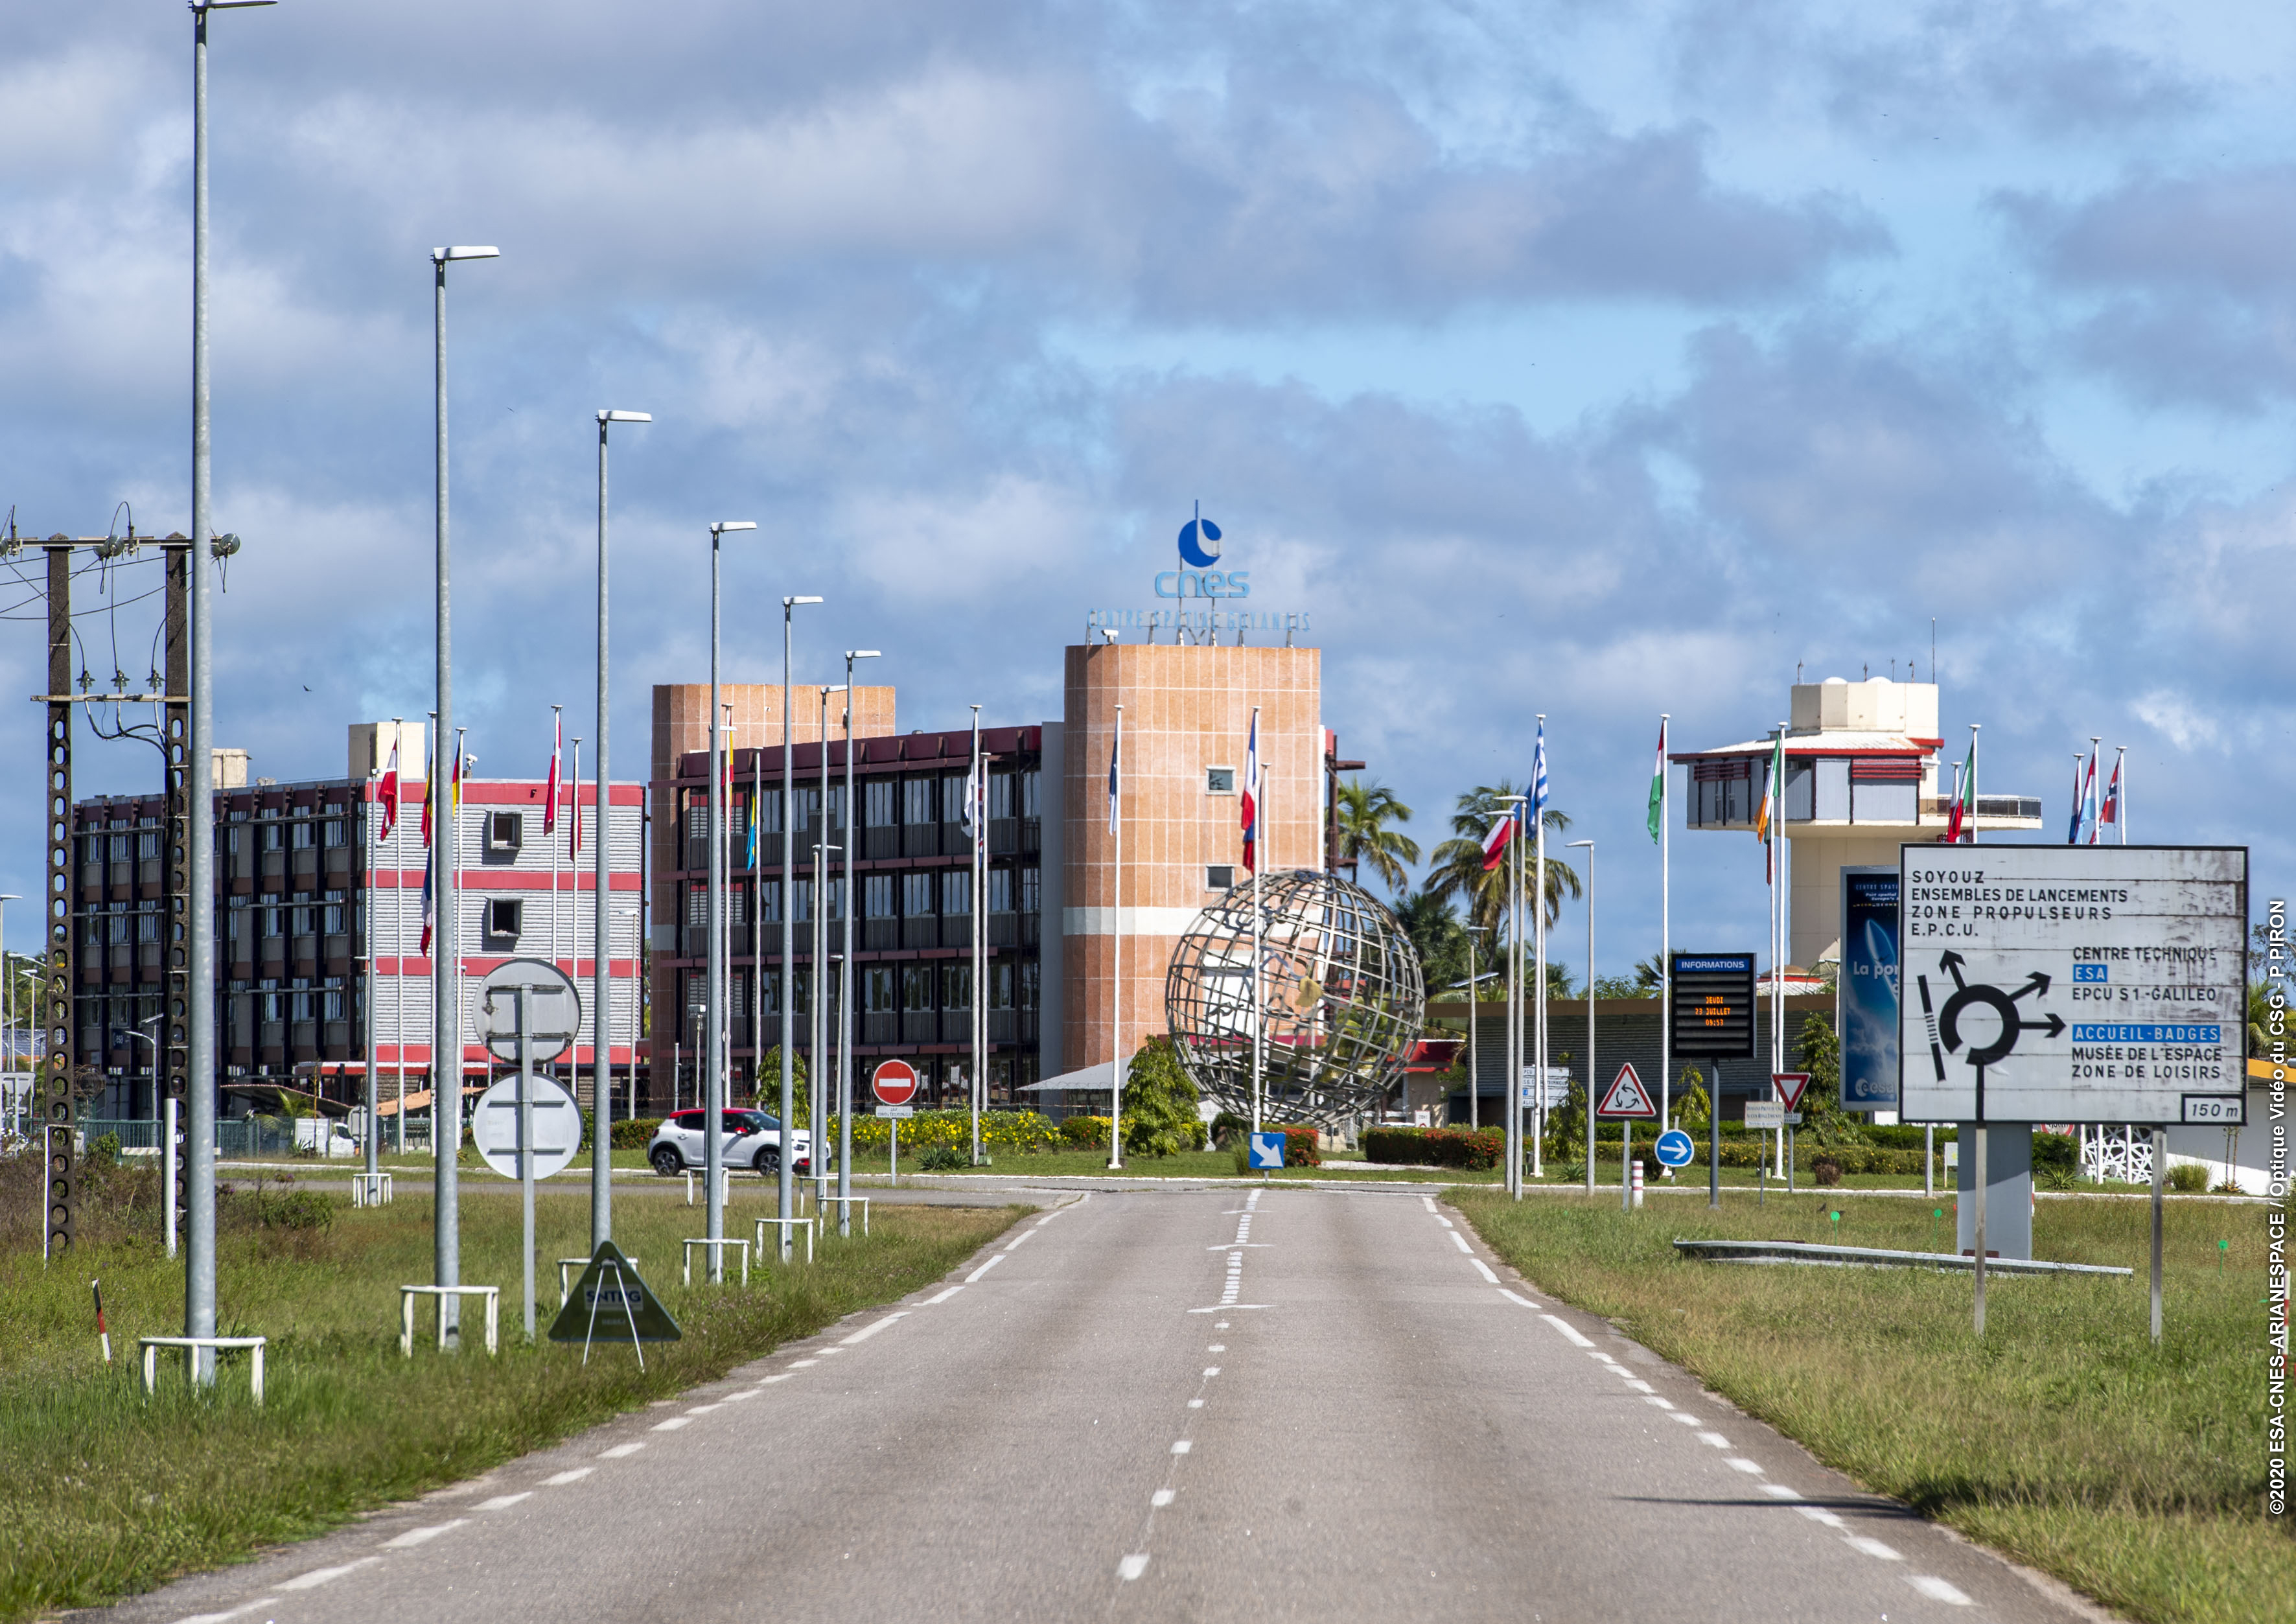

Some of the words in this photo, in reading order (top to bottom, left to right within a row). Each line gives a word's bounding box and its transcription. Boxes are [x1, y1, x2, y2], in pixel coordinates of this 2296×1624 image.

[1155, 570, 1251, 598] cnes
[1088, 608, 1145, 629] CENTRE
[1154, 609, 1219, 631] SPATIAL
[1912, 870, 1984, 883] SOYOUZ
[1912, 888, 2001, 901] ENSEMBLES
[2006, 888, 2024, 901] DE
[2029, 889, 2128, 903] LANCEMENTS
[1912, 905, 1960, 919] ZONE
[1974, 905, 2112, 920] PROPULSEURS
[1912, 923, 1978, 936] E.P.C.U.
[2073, 947, 2130, 960] CENTRE
[2134, 947, 2218, 962] TECHNIQUE
[1853, 961, 1869, 975] La
[1874, 964, 1899, 980] por
[2075, 966, 2105, 980] ESA
[2072, 988, 2113, 1001] EPCU
[2072, 1045, 2124, 1061] MUSÉE
[2128, 1047, 2147, 1061] DE
[2151, 1048, 2222, 1061] L'ESPACE
[2072, 1065, 2116, 1078] ZONE
[2125, 1065, 2145, 1078] DE
[2154, 1065, 2221, 1079] LOISIRS
[2192, 1104, 2221, 1117] 150
[2226, 1108, 2238, 1117] m
